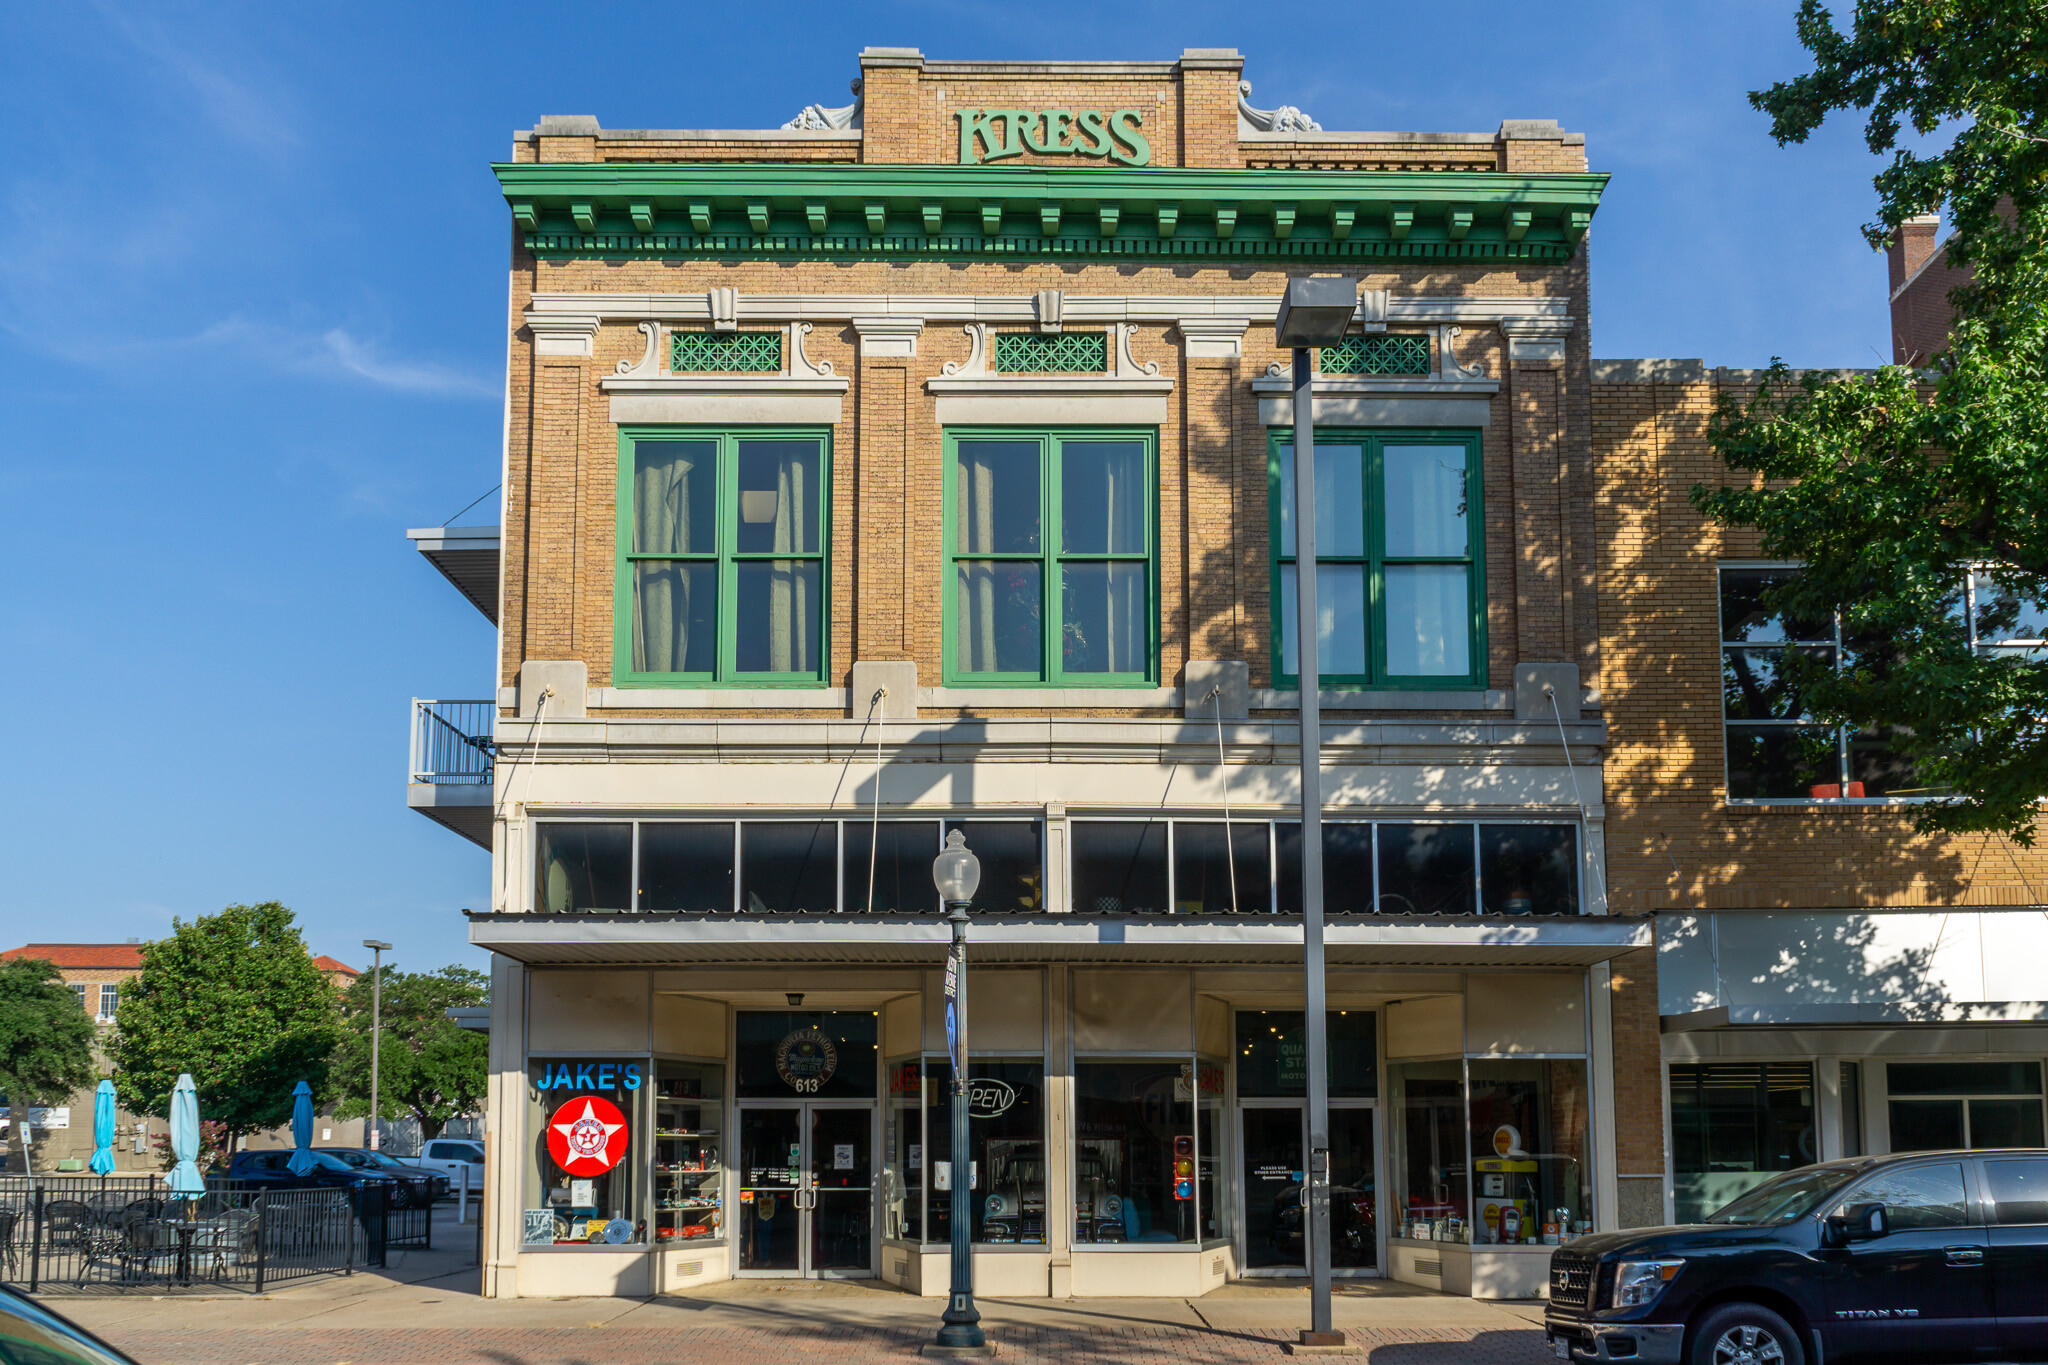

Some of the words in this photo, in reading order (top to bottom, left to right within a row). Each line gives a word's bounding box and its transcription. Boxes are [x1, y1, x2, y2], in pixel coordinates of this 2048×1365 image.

[956, 109, 1150, 167] KRESS
[537, 1063, 642, 1090] JAKE'S
[889, 1064, 917, 1093] JAKE'S
[1199, 1065, 1224, 1093] JAKE'S
[1280, 1072, 1306, 1080] MOTO
[795, 1078, 819, 1093] 613
[968, 1088, 1009, 1108] PEN
[574, 1119, 603, 1131] JAKES
[584, 1133, 591, 1142] J
[1835, 1309, 1890, 1319] TITAN
[1894, 1309, 1919, 1317] V8
